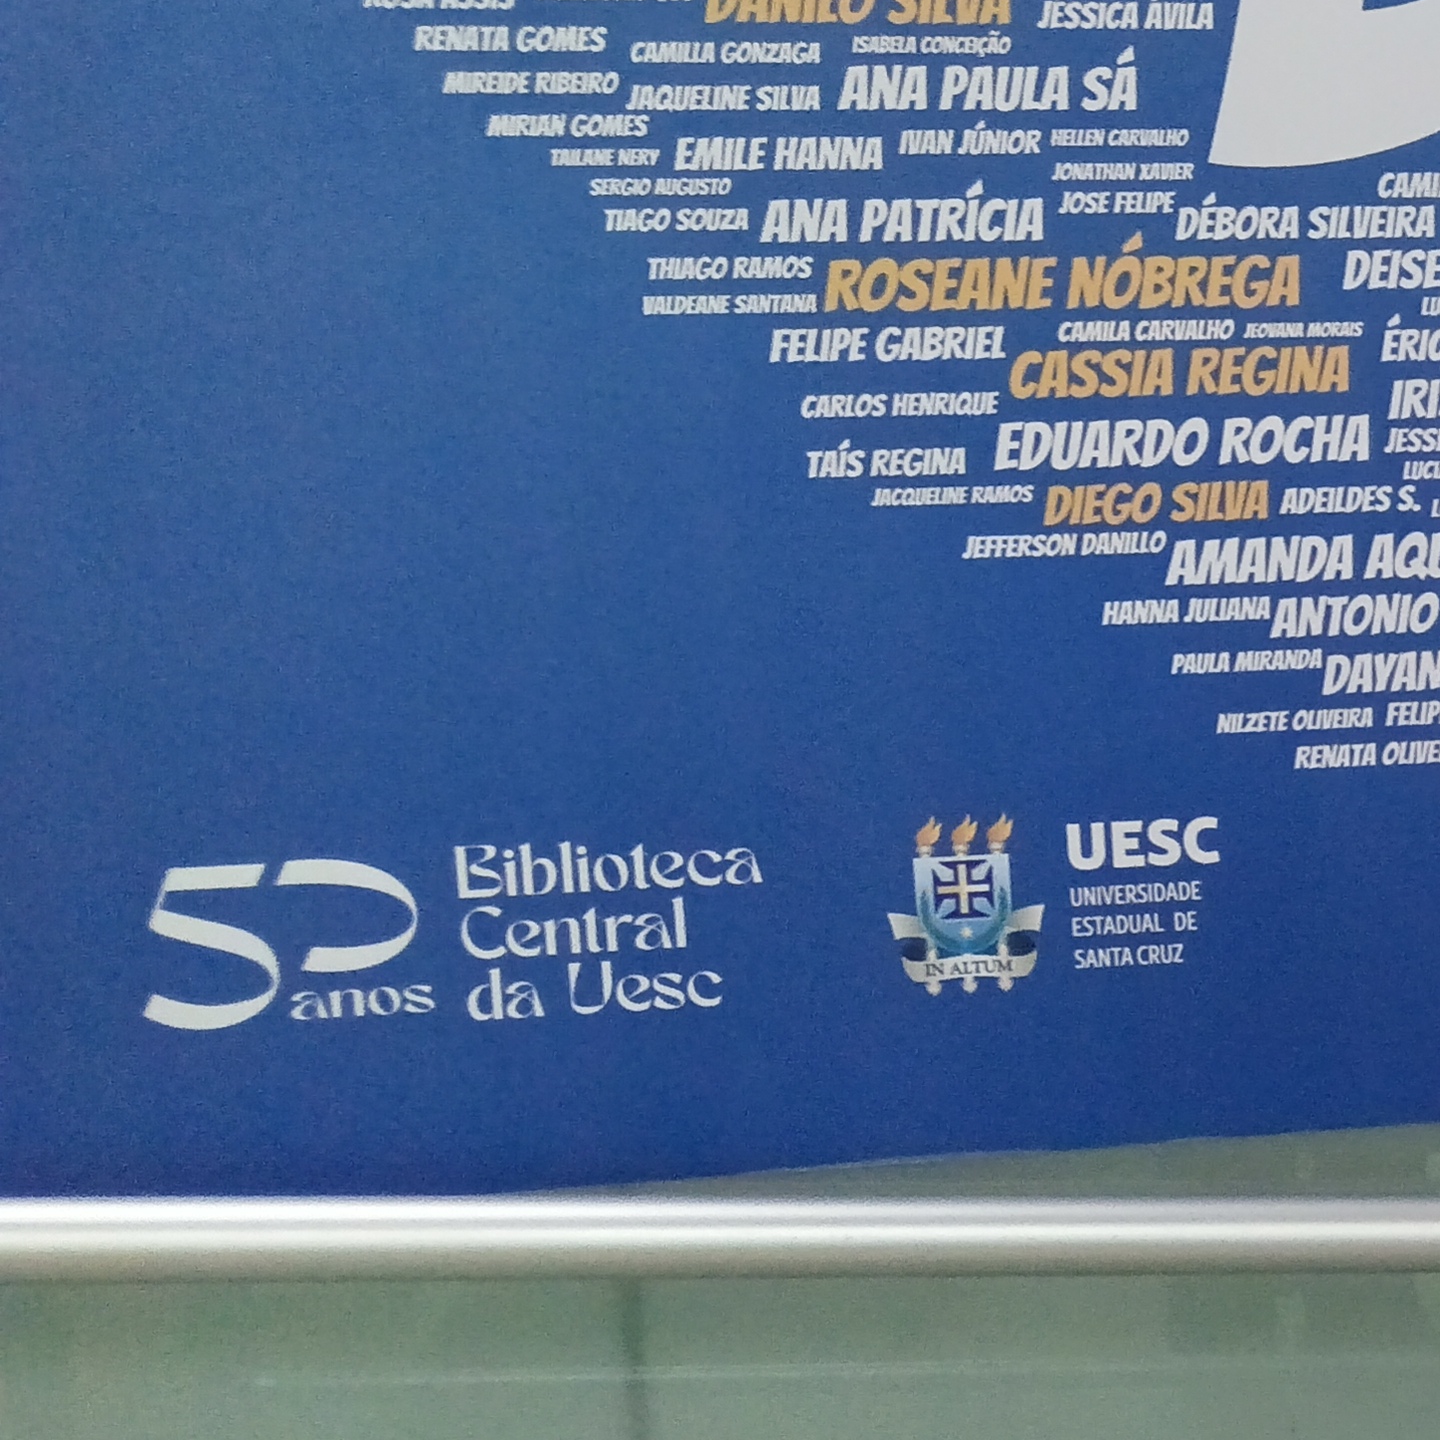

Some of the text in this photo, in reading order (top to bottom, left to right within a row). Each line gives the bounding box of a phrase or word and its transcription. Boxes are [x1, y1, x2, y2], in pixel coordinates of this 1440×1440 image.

[825, 232, 1299, 312] ROSEANE NÓBREGA
[1010, 346, 1348, 399] CASSIA REGINA
[994, 414, 1369, 470] EDUARDO ROCHA
[1044, 481, 1268, 525] DIEGO SILVA
[454, 840, 764, 899] Biblioteca
[1066, 816, 1221, 871] UESC
[1069, 881, 1202, 907] UNIVERSIDADE
[460, 897, 688, 961] Central
[1072, 911, 1198, 938] ESTADUAL DE
[925, 959, 1013, 977] IN ALTUM
[1074, 944, 1184, 970] SANTA CRUZ
[290, 984, 435, 1021] anos
[466, 961, 724, 1021] da Uesc
